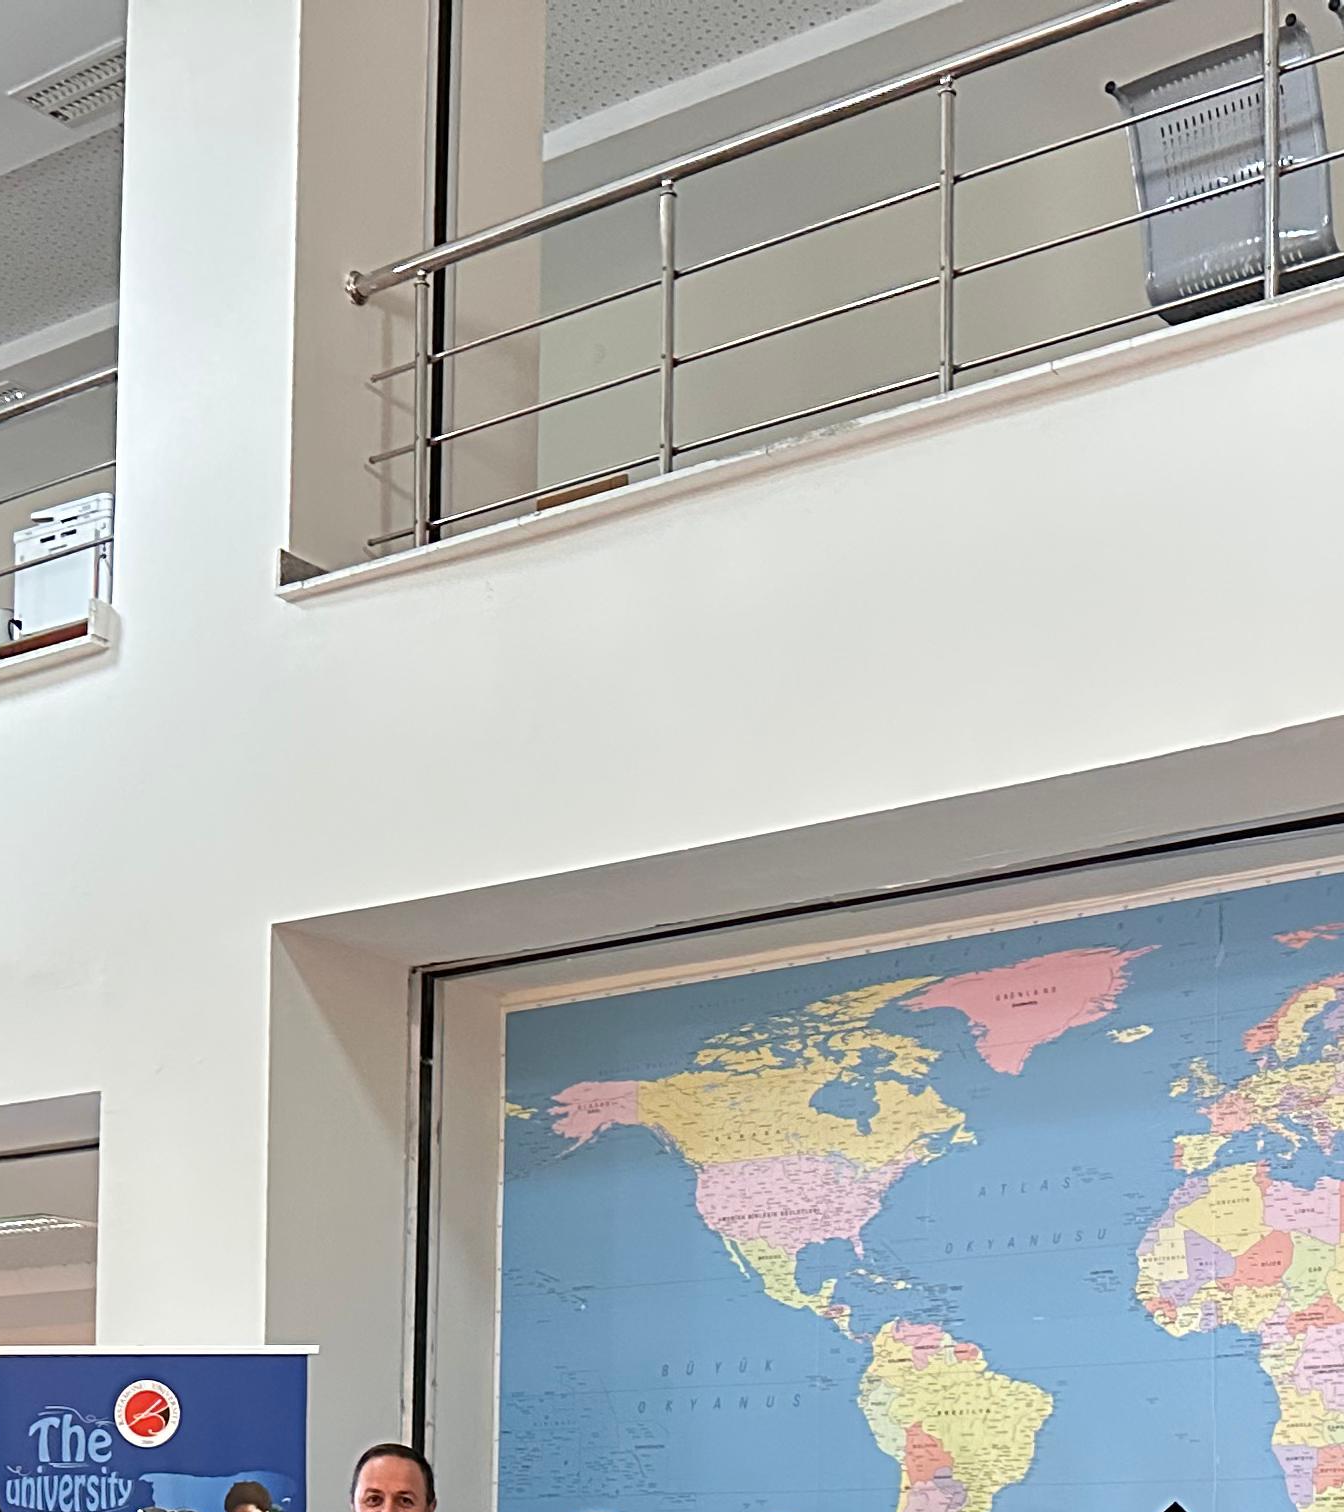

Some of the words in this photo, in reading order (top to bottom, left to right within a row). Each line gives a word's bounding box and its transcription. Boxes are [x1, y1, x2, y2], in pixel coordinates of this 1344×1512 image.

[977, 1176, 1072, 1197] ATLAS
[944, 1228, 1107, 1255] OKYANUSU
[661, 1359, 775, 1377] BÜYÜK
[637, 1393, 801, 1414] OKYANUS
[28, 1414, 112, 1463] The
[6, 1466, 132, 1512] university
